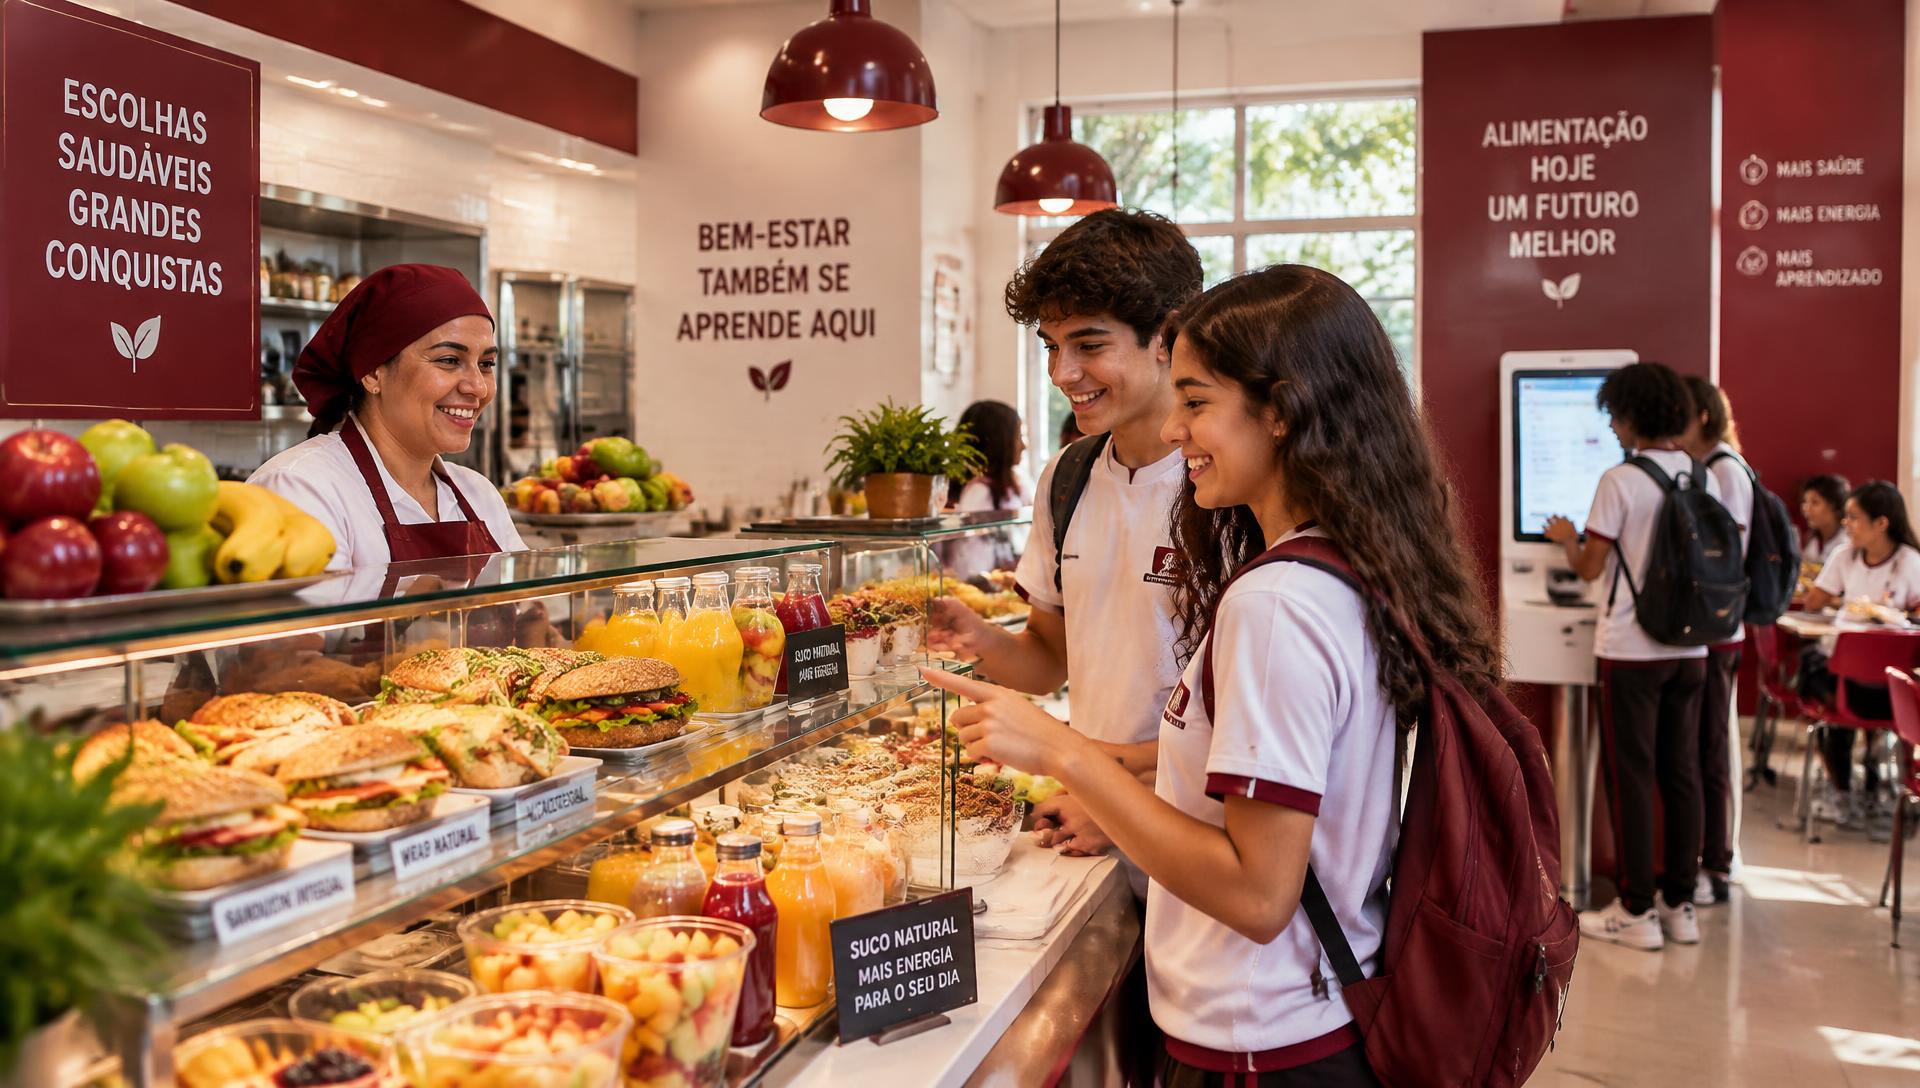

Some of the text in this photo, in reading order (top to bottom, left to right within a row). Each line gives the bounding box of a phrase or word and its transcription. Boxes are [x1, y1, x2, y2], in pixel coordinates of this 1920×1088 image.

[64, 77, 207, 145] ESCOLHAS
[1482, 110, 1648, 149] ALIMENTAÇÃO
[58, 132, 212, 195] SAUDÁVEIS
[1531, 153, 1596, 183] HOJE
[1776, 154, 1865, 178] MAIS SAÚDE
[68, 188, 201, 244] GRANDES
[1487, 190, 1640, 222] UM FUTURO
[1776, 203, 1881, 224] MAIS ENERGIA
[698, 217, 851, 252] BEM-ESTAR
[1509, 228, 1616, 259] MELHOR
[45, 239, 223, 296] CONQUISTAS
[1775, 248, 1814, 268] MAIS
[698, 258, 850, 296] TAMBÉM SE
[1775, 268, 1883, 288] APRENDIZADO
[676, 308, 876, 342] APRENDE AQUI
[850, 916, 959, 960] SUCO NATURAL
[858, 945, 954, 987] MAIS ENERGIA
[854, 968, 961, 1014] PARA O SEU DIA
